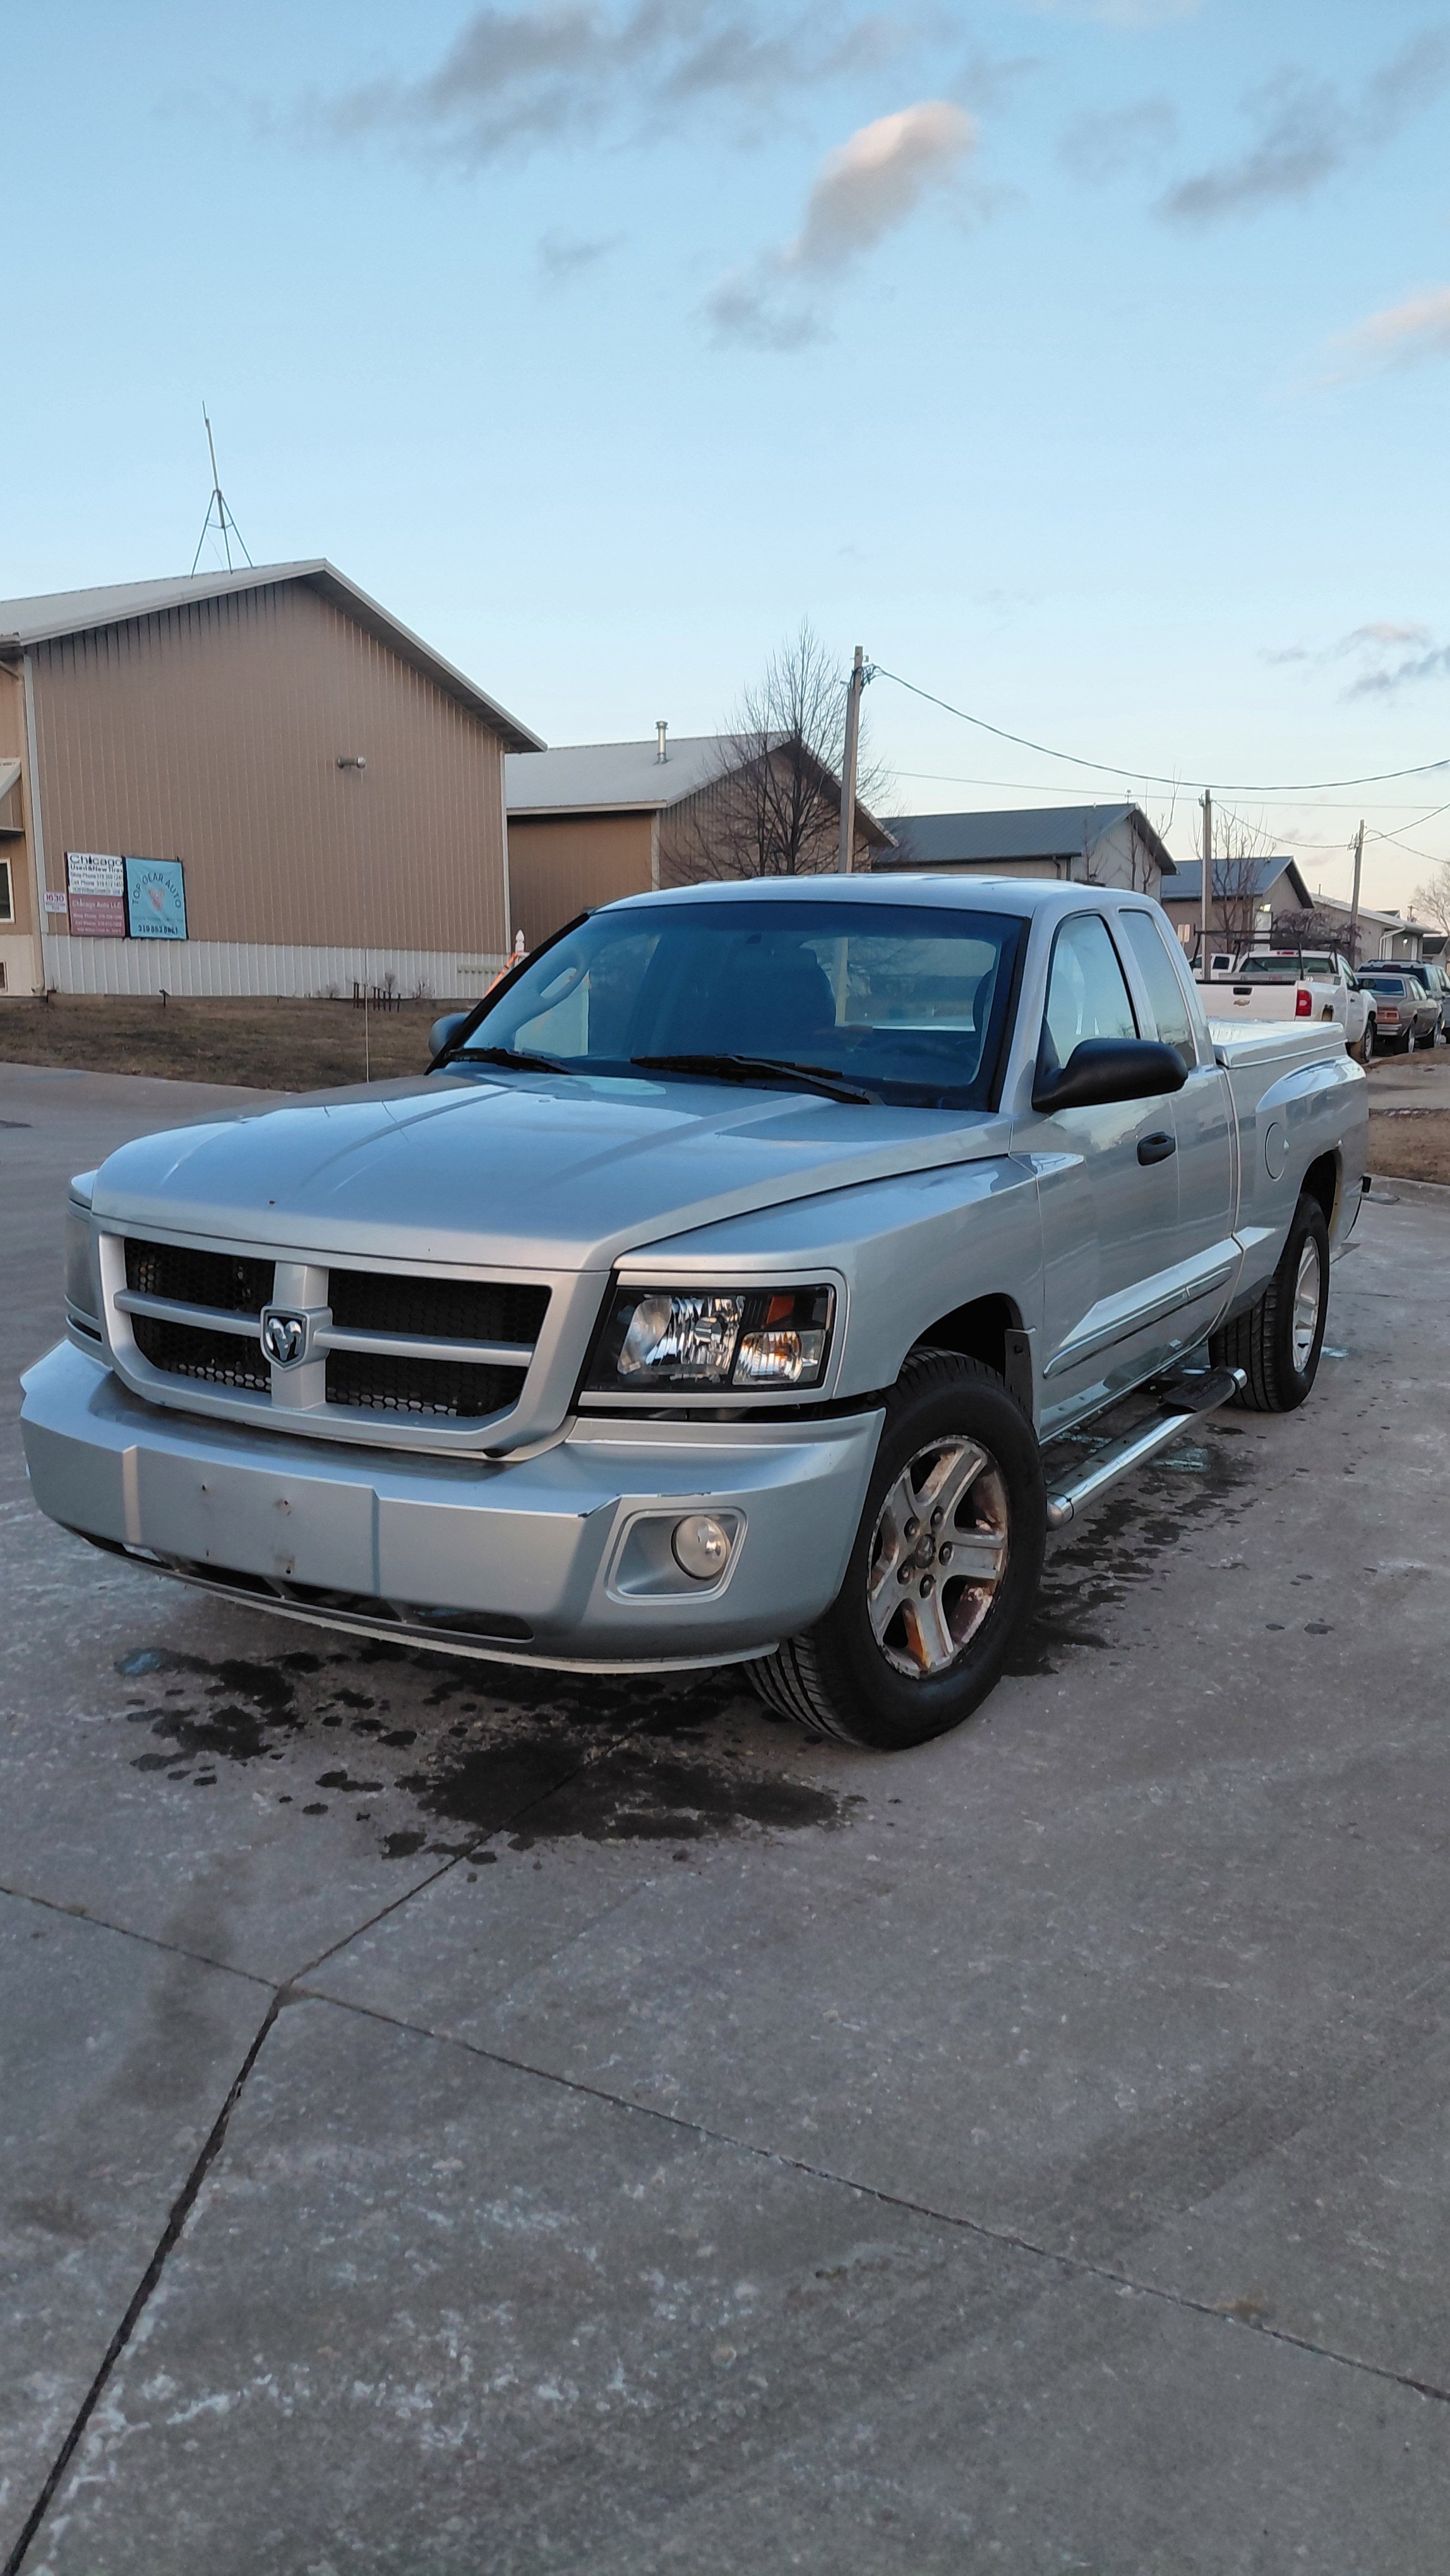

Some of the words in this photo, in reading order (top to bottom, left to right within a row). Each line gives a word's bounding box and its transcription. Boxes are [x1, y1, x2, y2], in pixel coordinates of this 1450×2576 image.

[69, 854, 123, 866] Chicago
[132, 883, 141, 905] TOP
[165, 879, 181, 909] AUTO
